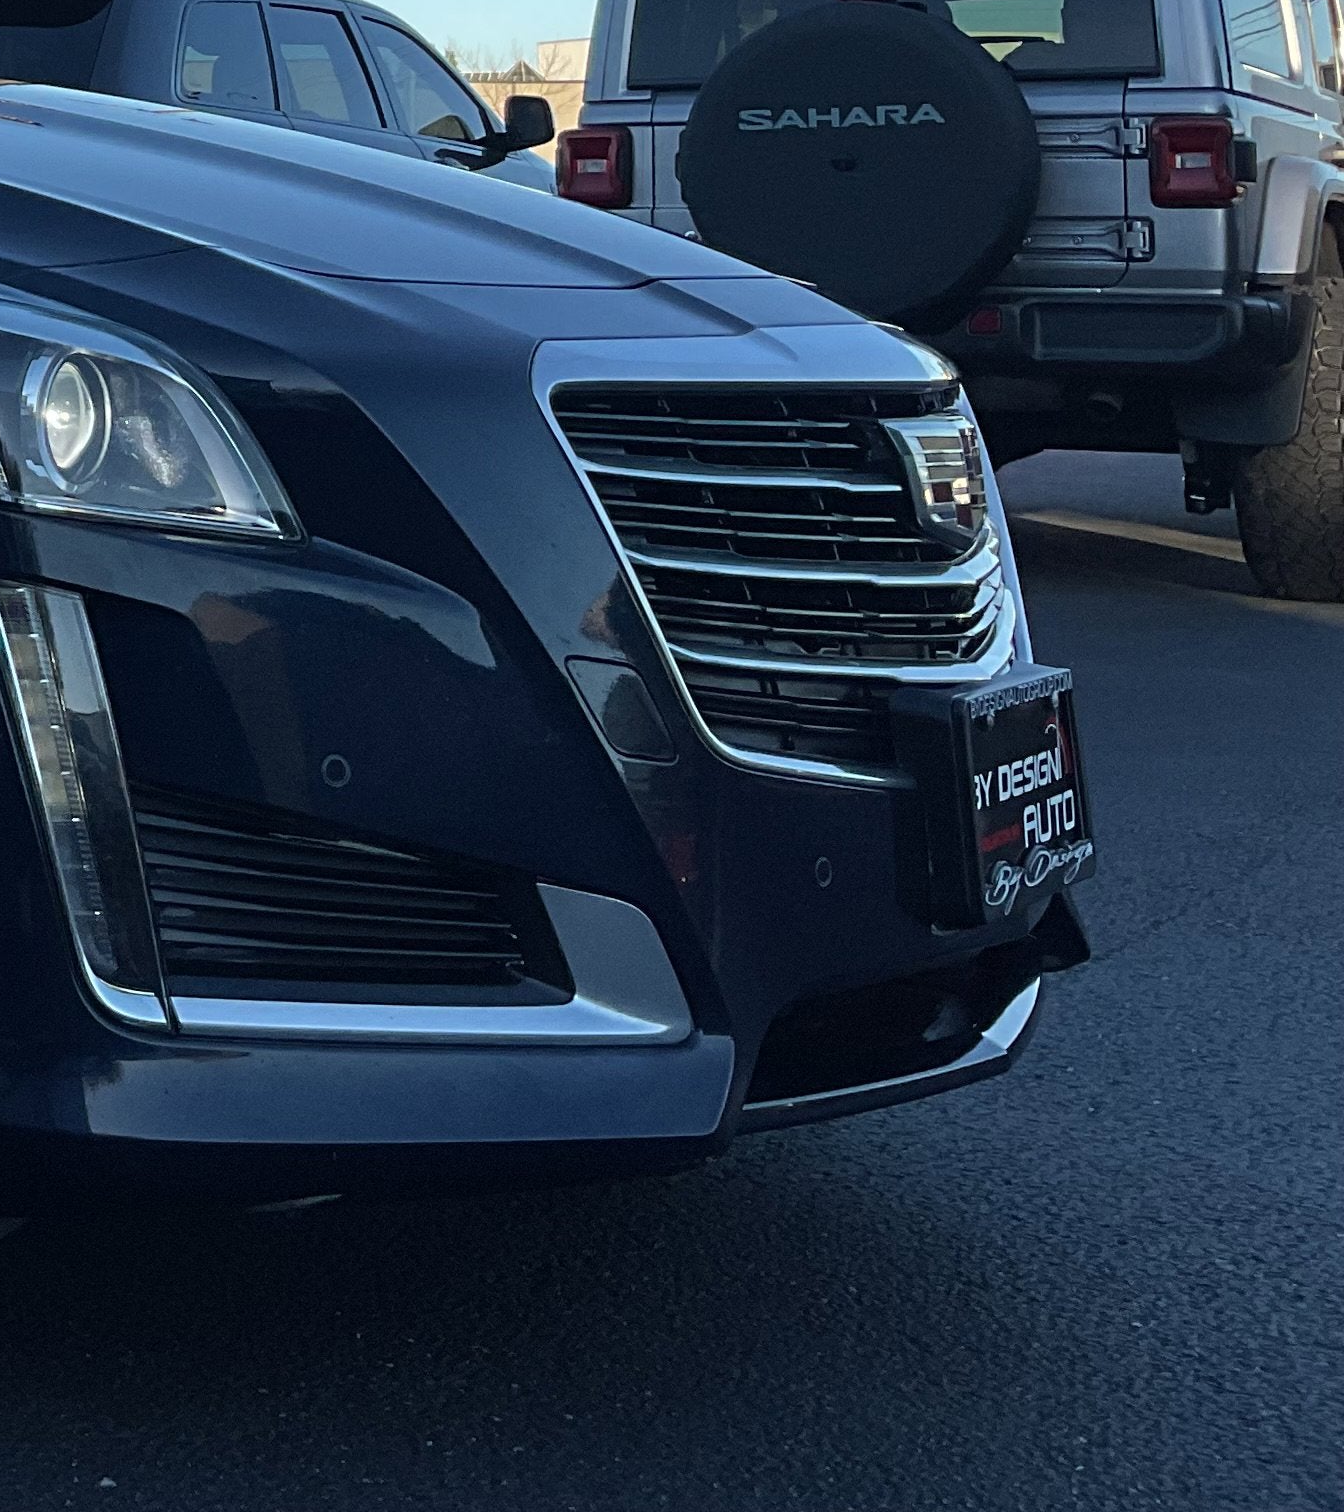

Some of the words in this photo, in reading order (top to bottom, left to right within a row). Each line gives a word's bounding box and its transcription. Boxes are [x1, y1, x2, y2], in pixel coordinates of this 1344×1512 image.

[738, 103, 944, 131] SAHARA
[997, 748, 1060, 803] DESIGN
[1023, 789, 1075, 848] AUTO
[985, 864, 1024, 916] By
